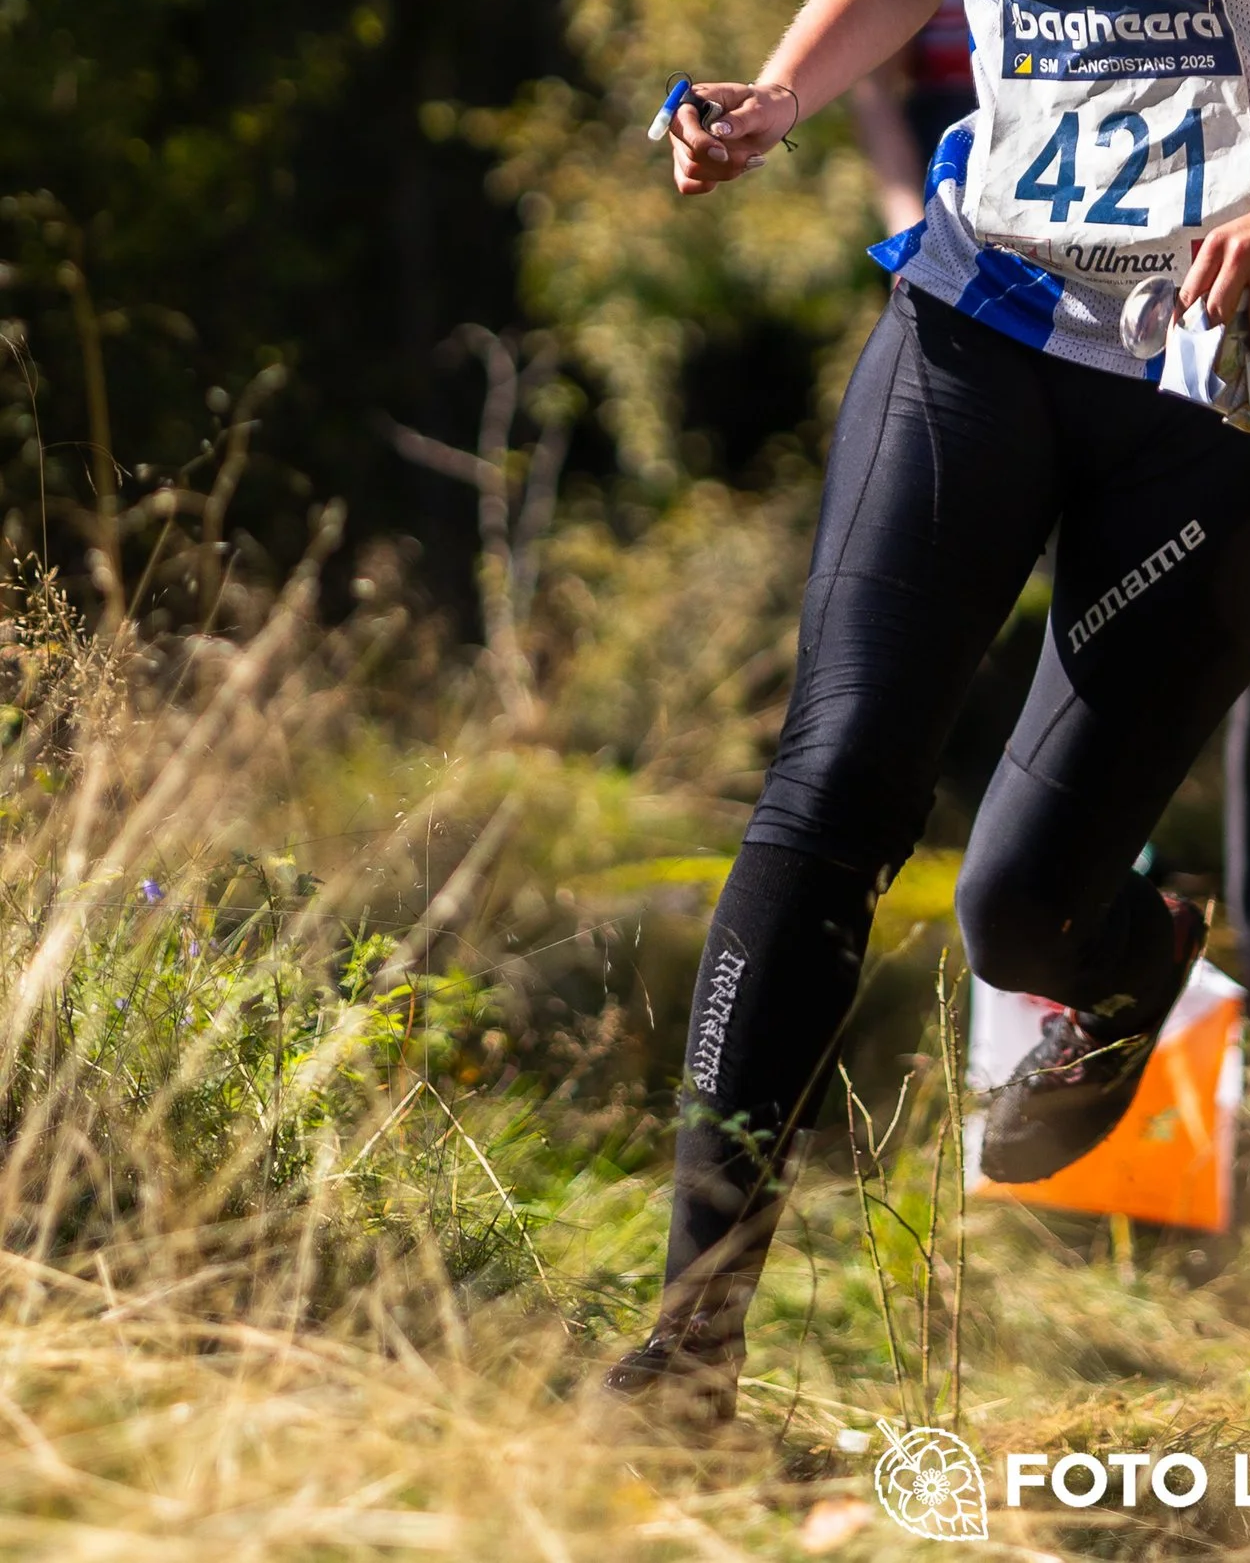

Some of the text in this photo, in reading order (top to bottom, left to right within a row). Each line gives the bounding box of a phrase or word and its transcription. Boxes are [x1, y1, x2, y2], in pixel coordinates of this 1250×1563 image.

[1012, 2, 1225, 50] bagheera
[1039, 58, 1059, 73] SM
[1180, 55, 1216, 70] 2025
[1014, 107, 1205, 227] 421
[1065, 244, 1176, 274] Ullmax
[1067, 519, 1206, 655] noname
